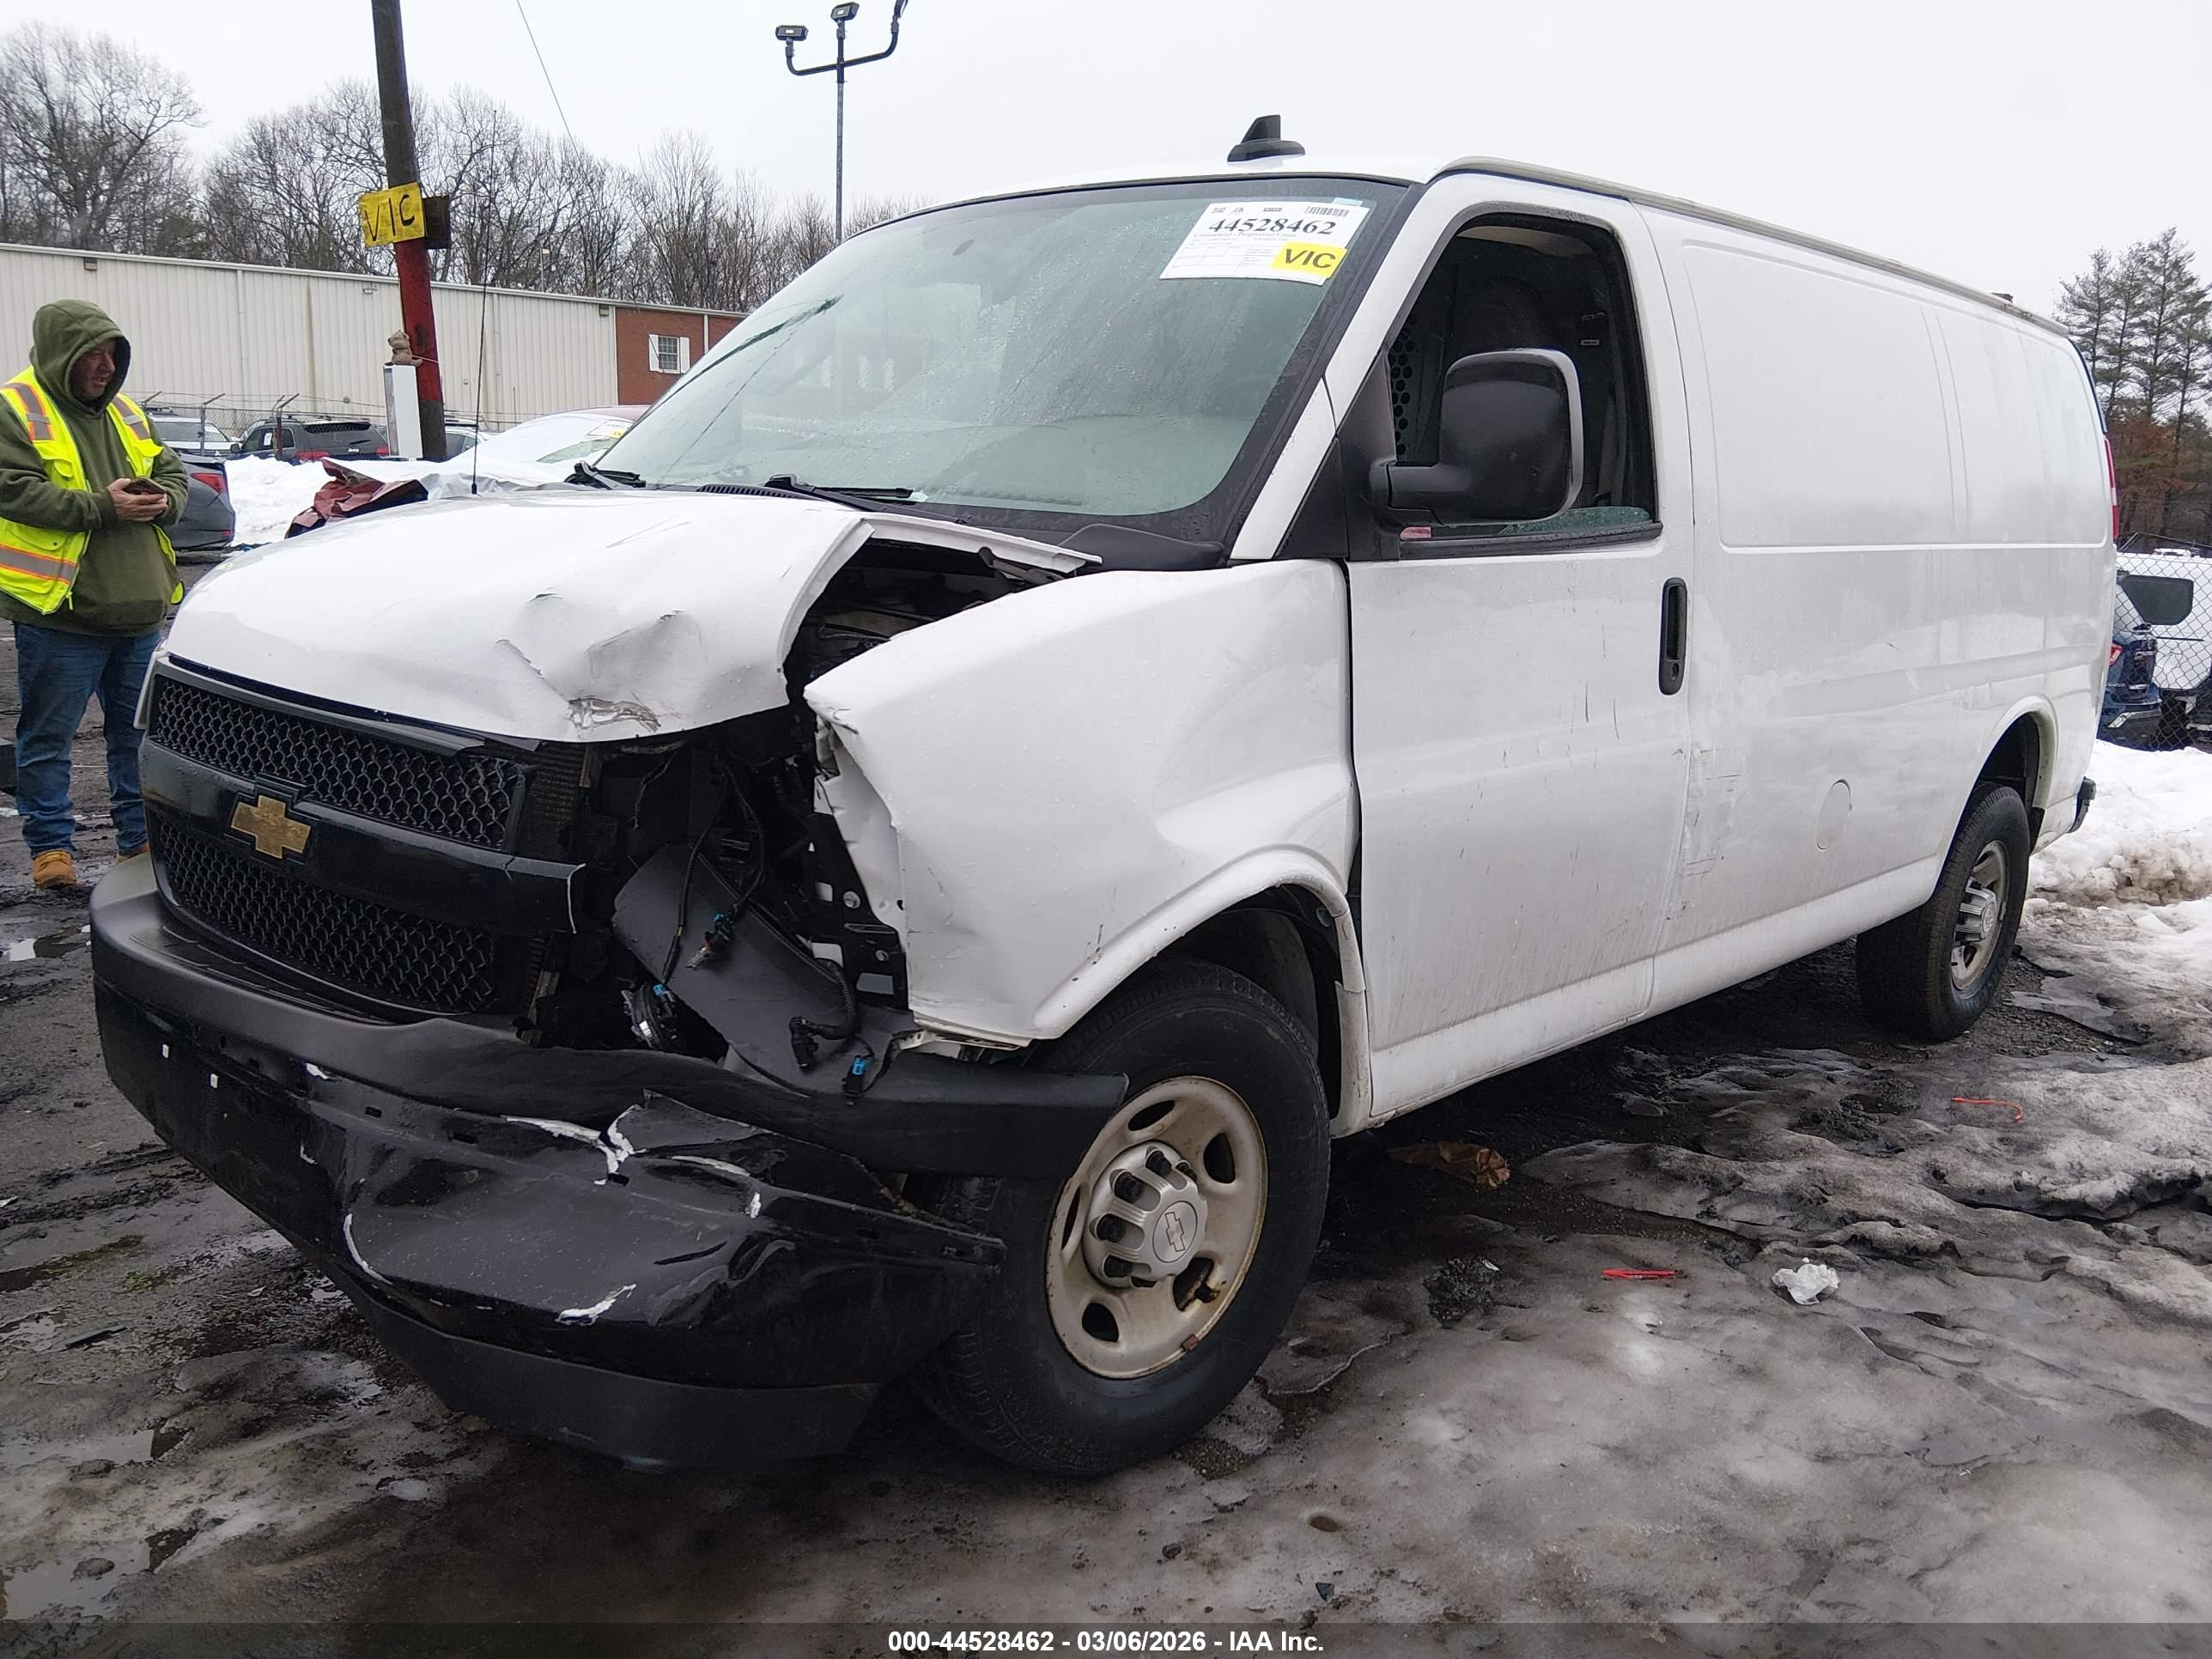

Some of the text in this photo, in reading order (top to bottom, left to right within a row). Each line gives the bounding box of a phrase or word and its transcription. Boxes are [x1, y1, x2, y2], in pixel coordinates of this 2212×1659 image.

[364, 193, 415, 242] VIC
[1208, 218, 1337, 235] 44528462
[1285, 247, 1337, 269] VIC
